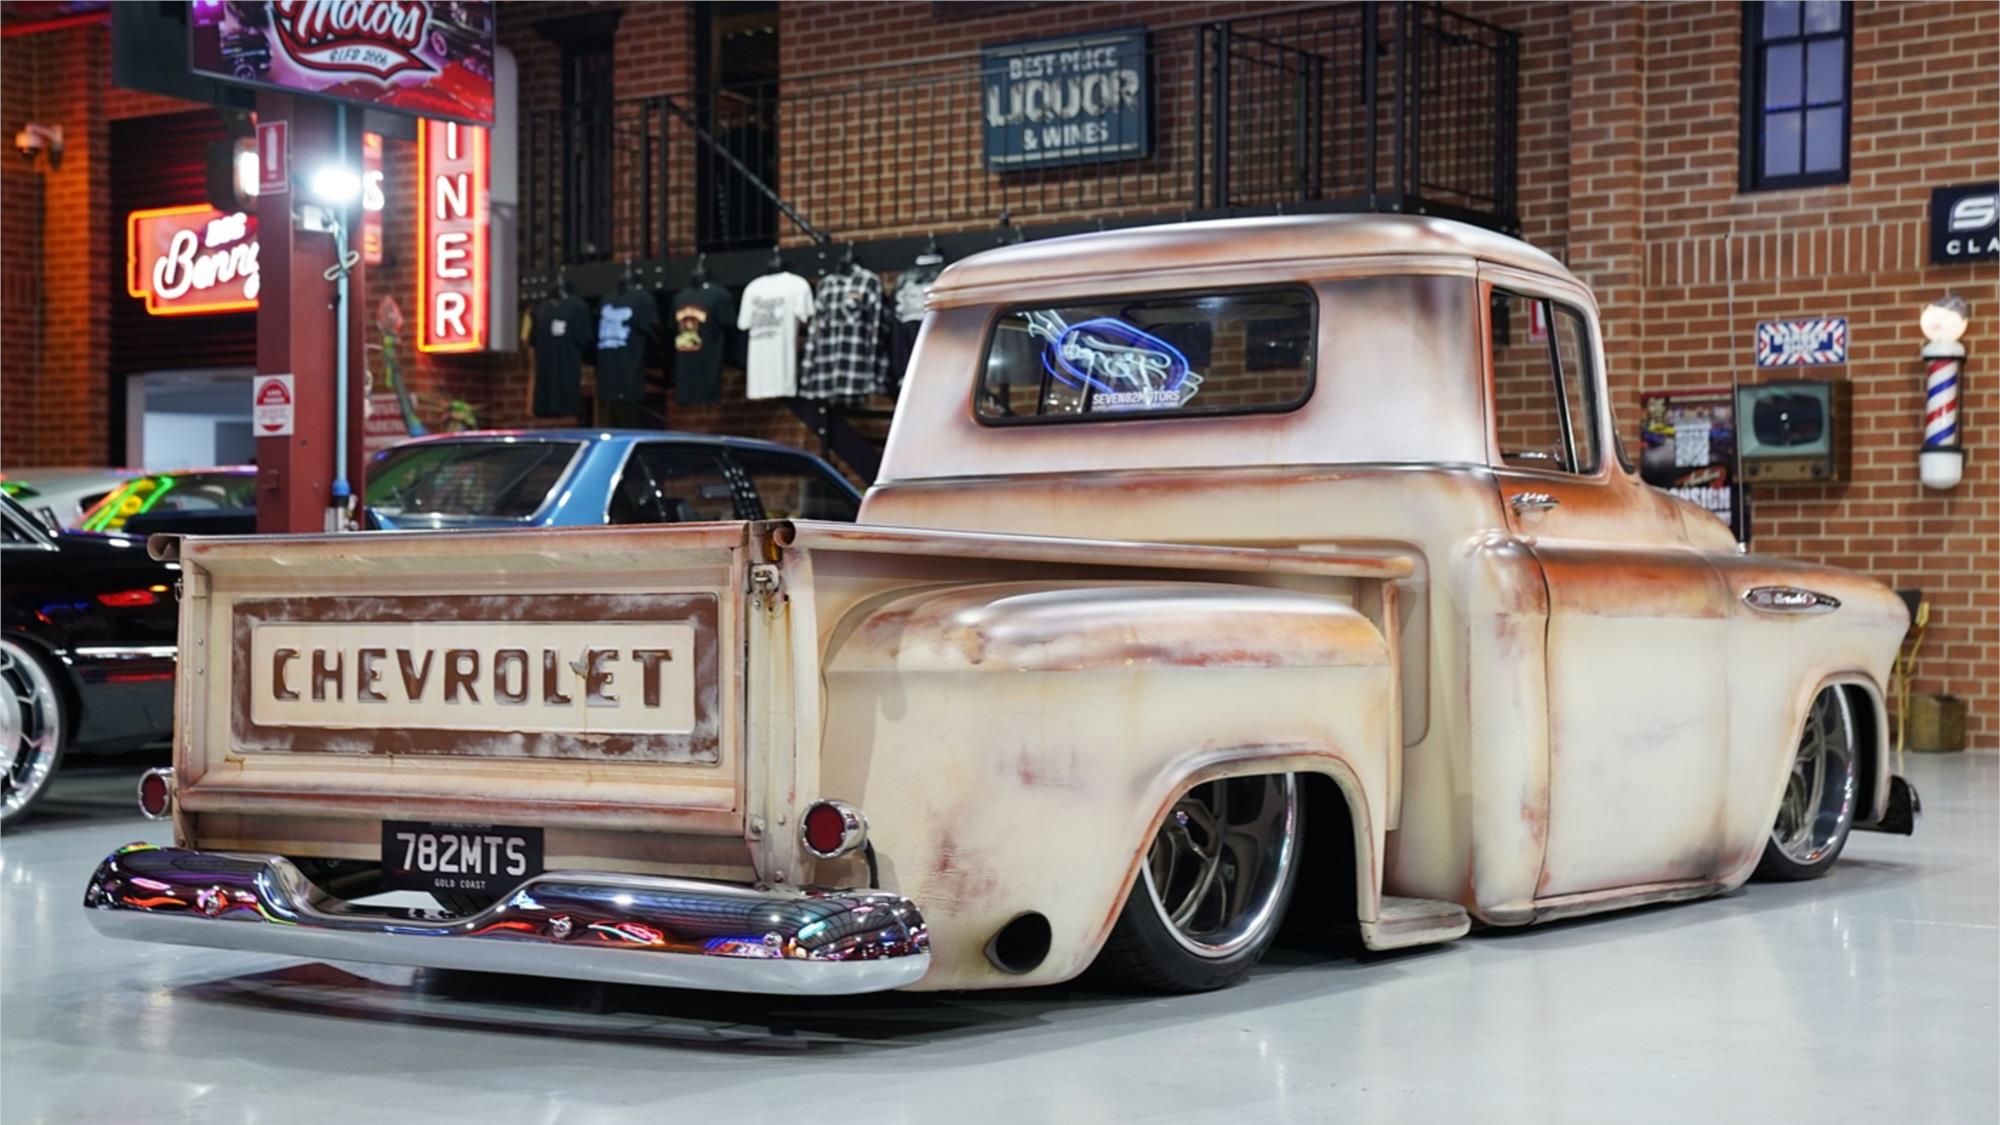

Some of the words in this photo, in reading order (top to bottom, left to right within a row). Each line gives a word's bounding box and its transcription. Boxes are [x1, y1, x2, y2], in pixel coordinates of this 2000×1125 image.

[294, 1, 421, 41] Motors
[1009, 54, 1057, 80] BEST
[1060, 47, 1118, 73] PRICE
[987, 70, 1139, 127] LIQUOR
[1023, 128, 1038, 150] &
[1042, 122, 1109, 148] WINES
[1668, 486, 1732, 510] NSIGN
[272, 648, 674, 708] CHEVROLET
[397, 833, 527, 876] 782MTS
[434, 878, 455, 888] GOLD
[460, 879, 486, 889] COAST
